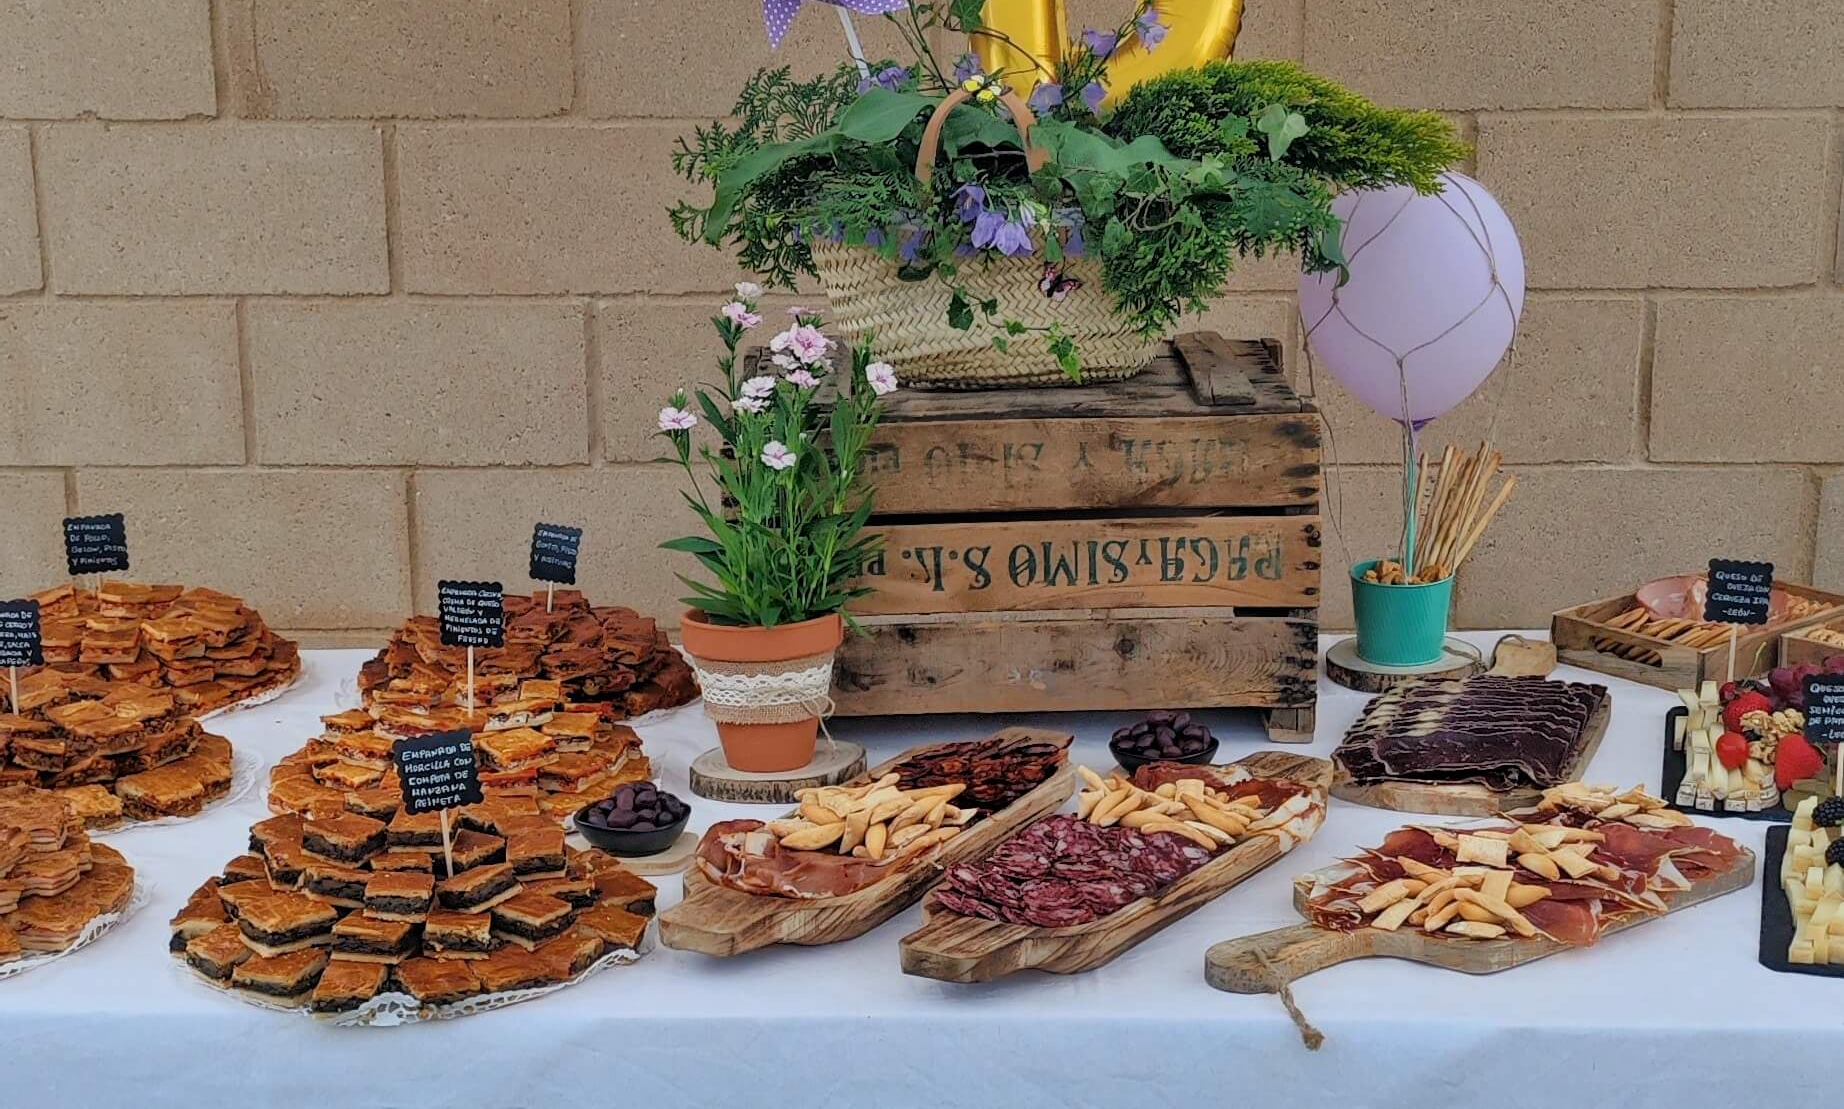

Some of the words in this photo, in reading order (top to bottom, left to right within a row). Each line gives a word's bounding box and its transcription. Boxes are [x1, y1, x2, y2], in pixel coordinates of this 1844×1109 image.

[70, 534, 80, 542] DE
[71, 558, 78, 566] Y
[21, 611, 33, 619] DE
[444, 614, 488, 624] MERMELADA
[490, 617, 500, 625] DE
[485, 627, 498, 635] DE
[1808, 716, 1822, 726] DE
[402, 745, 456, 761] EMPANADA
[459, 742, 471, 752] DE
[405, 760, 451, 773] MORCILLA
[454, 758, 472, 766] CON
[408, 773, 450, 785] COMPOTA
[454, 770, 468, 780] DE
[412, 782, 466, 796] MANZANA
[415, 794, 461, 809] REINETA
